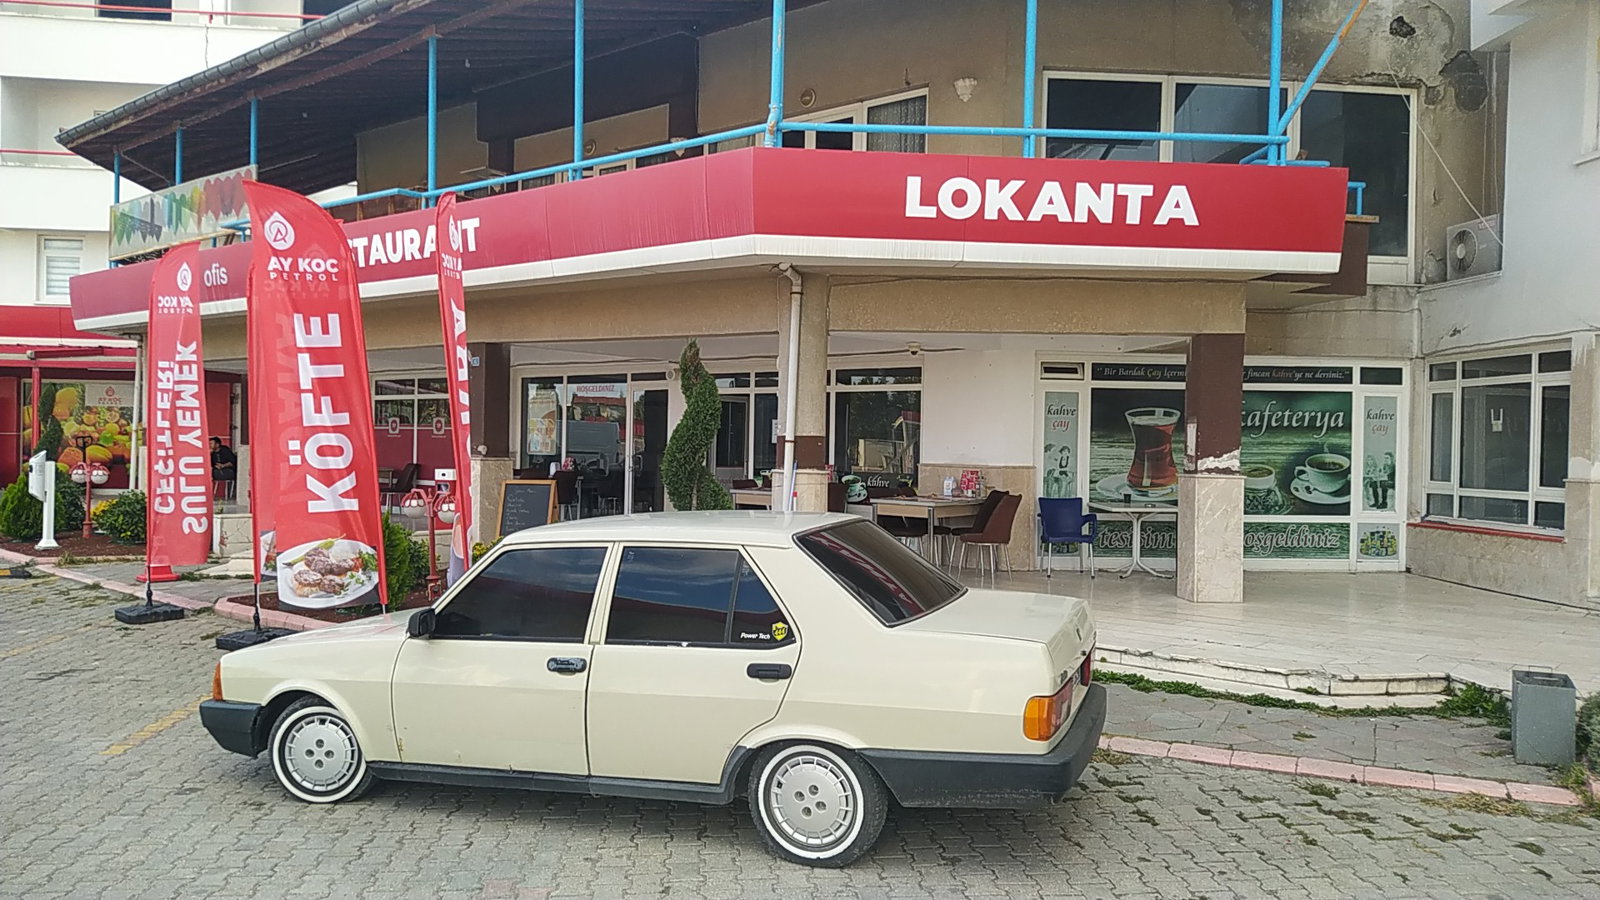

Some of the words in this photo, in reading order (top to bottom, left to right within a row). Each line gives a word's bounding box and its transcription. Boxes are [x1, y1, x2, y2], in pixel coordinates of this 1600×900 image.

[905, 175, 1200, 226] LOKANTA
[347, 217, 480, 268] TAURAT
[267, 256, 293, 272] AY
[298, 257, 339, 273] KOC
[203, 262, 229, 287] ofis
[269, 271, 339, 282] PETROL
[1119, 367, 1145, 377] Bardak
[1147, 368, 1161, 379] Çay
[1247, 369, 1270, 380] fincan
[288, 313, 359, 513] KÖFTE
[1047, 404, 1076, 416] kahve
[1366, 408, 1395, 420] kahve
[1053, 420, 1070, 432] çay
[1372, 424, 1389, 436] çay
[1244, 524, 1341, 557] oşgeldiniz
